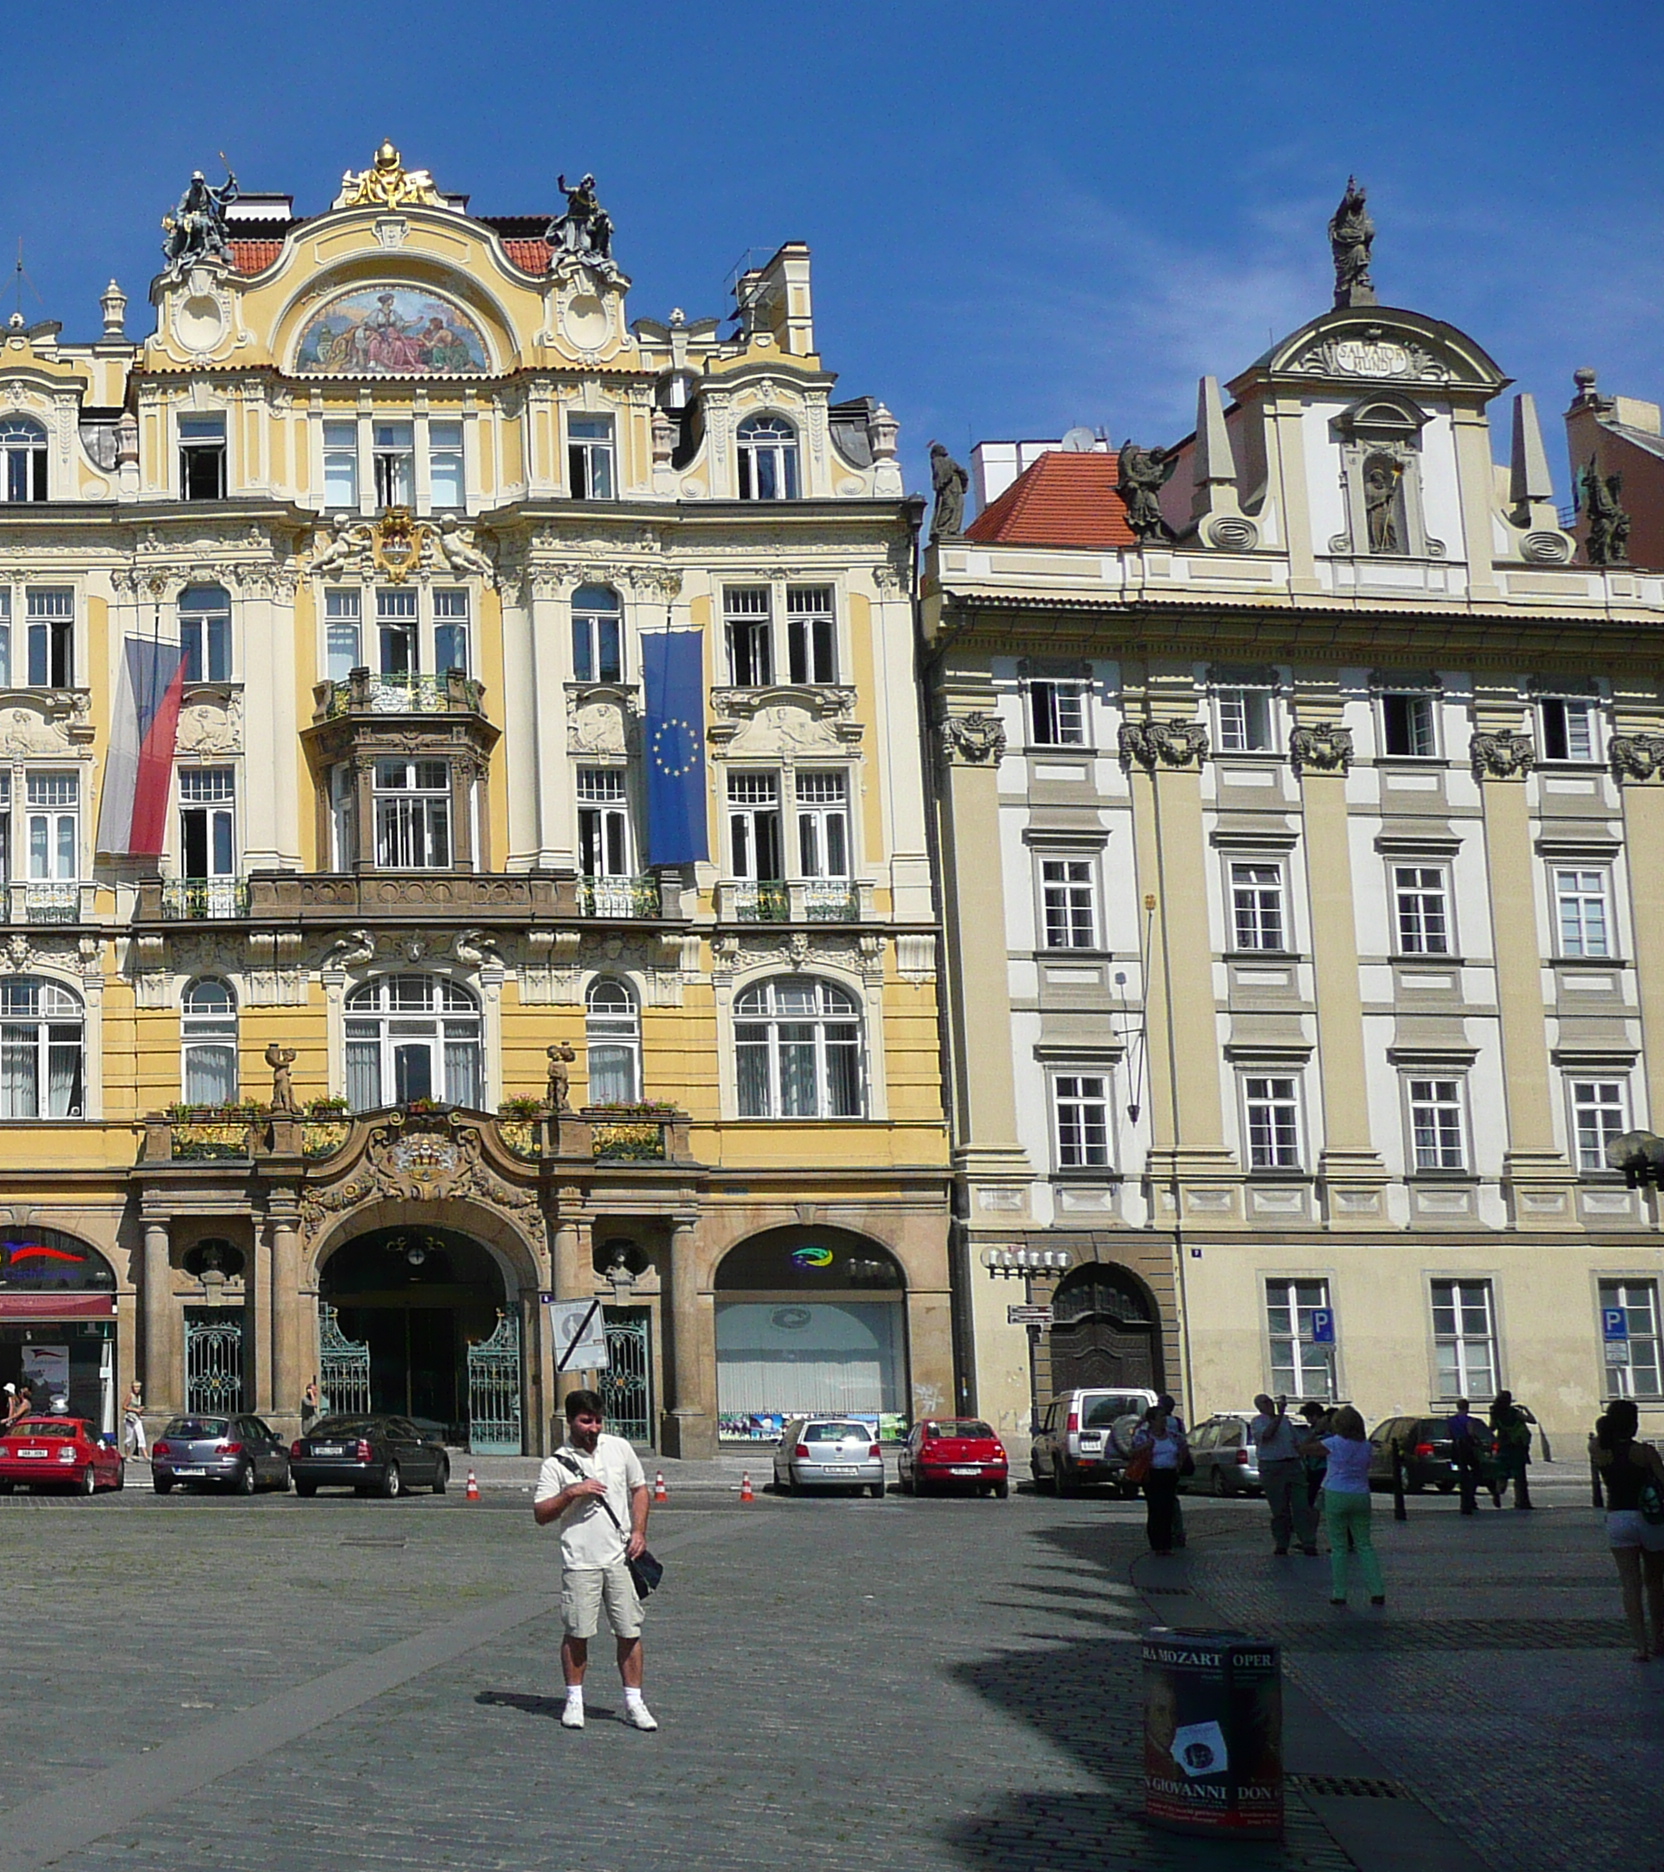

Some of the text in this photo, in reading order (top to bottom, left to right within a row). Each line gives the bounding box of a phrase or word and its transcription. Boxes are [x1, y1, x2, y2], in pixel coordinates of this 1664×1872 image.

[1339, 344, 1404, 361] SALVATOR
[1353, 356, 1393, 371] MUNDI
[1314, 1312, 1328, 1333] P
[1606, 1311, 1621, 1331] P
[1158, 1648, 1222, 1666] MOZART
[1232, 1654, 1273, 1666] OPER
[1152, 1777, 1227, 1801] GIOVANNI
[1237, 1785, 1271, 1800] DON
